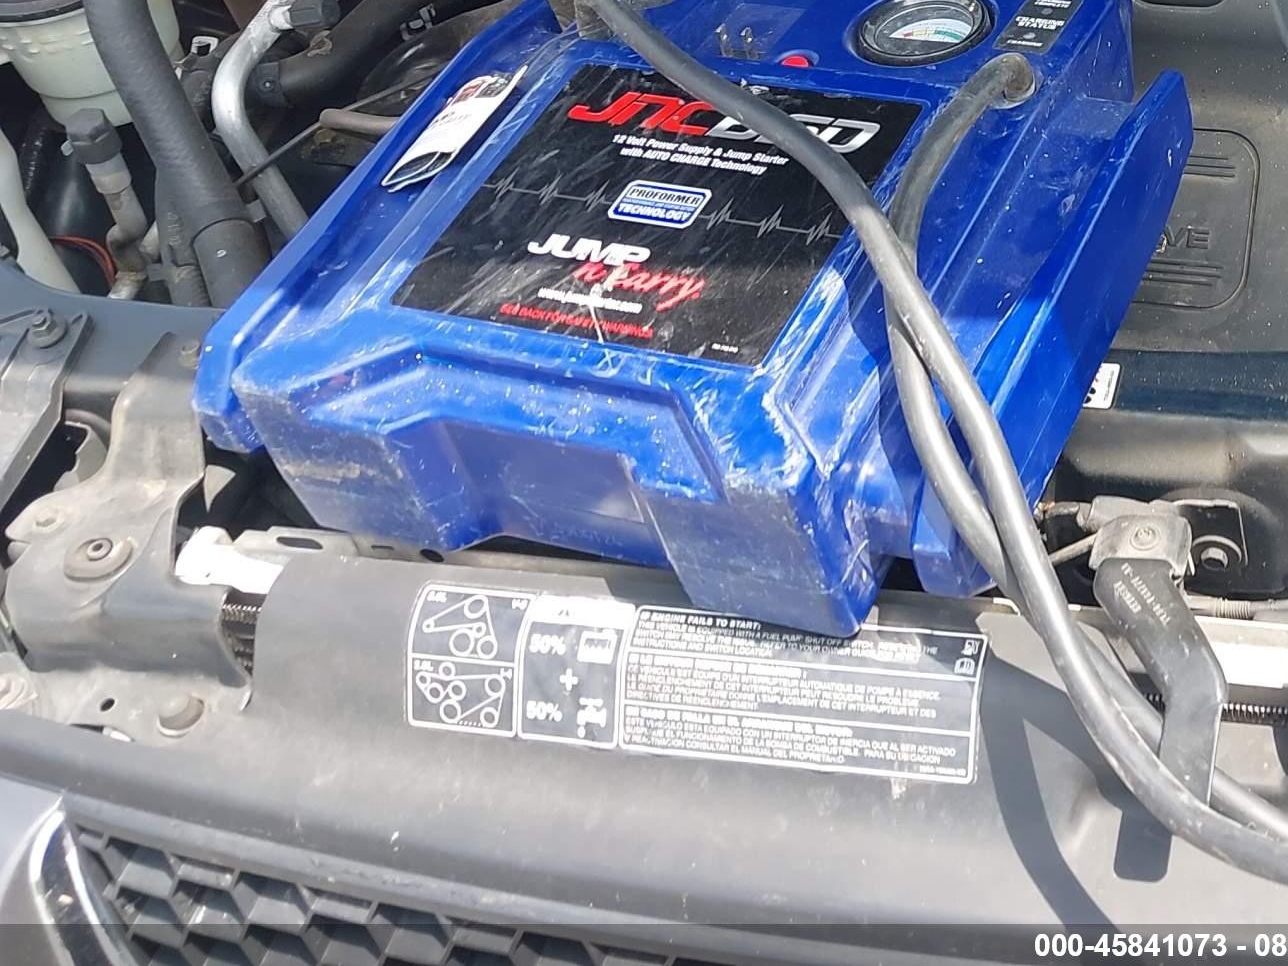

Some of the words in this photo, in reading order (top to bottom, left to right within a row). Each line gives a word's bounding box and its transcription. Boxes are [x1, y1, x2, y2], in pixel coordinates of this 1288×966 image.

[1015, 15, 1065, 27] CHARGING
[1017, 20, 1057, 30] STATUS
[612, 134, 625, 145] 12
[625, 135, 646, 148] Volt
[646, 138, 679, 152] Power
[680, 141, 713, 158] Supply
[714, 147, 722, 156] &
[723, 148, 752, 163] Jump
[752, 151, 790, 166] Starter
[620, 147, 644, 159] with
[644, 149, 670, 162] AUTO
[670, 152, 712, 166] CHARGE
[711, 158, 768, 176] Technology
[628, 187, 702, 206] PROFORMER
[617, 203, 692, 222] TECHNOLOGY
[527, 233, 651, 266] JUMP
[651, 611, 686, 623] ENGINE
[687, 615, 712, 625] FAILS
[715, 617, 727, 627] TO
[729, 618, 761, 629] START:
[529, 634, 567, 656] 50%
[762, 631, 779, 640] FUEL
[526, 699, 563, 722] 50%
